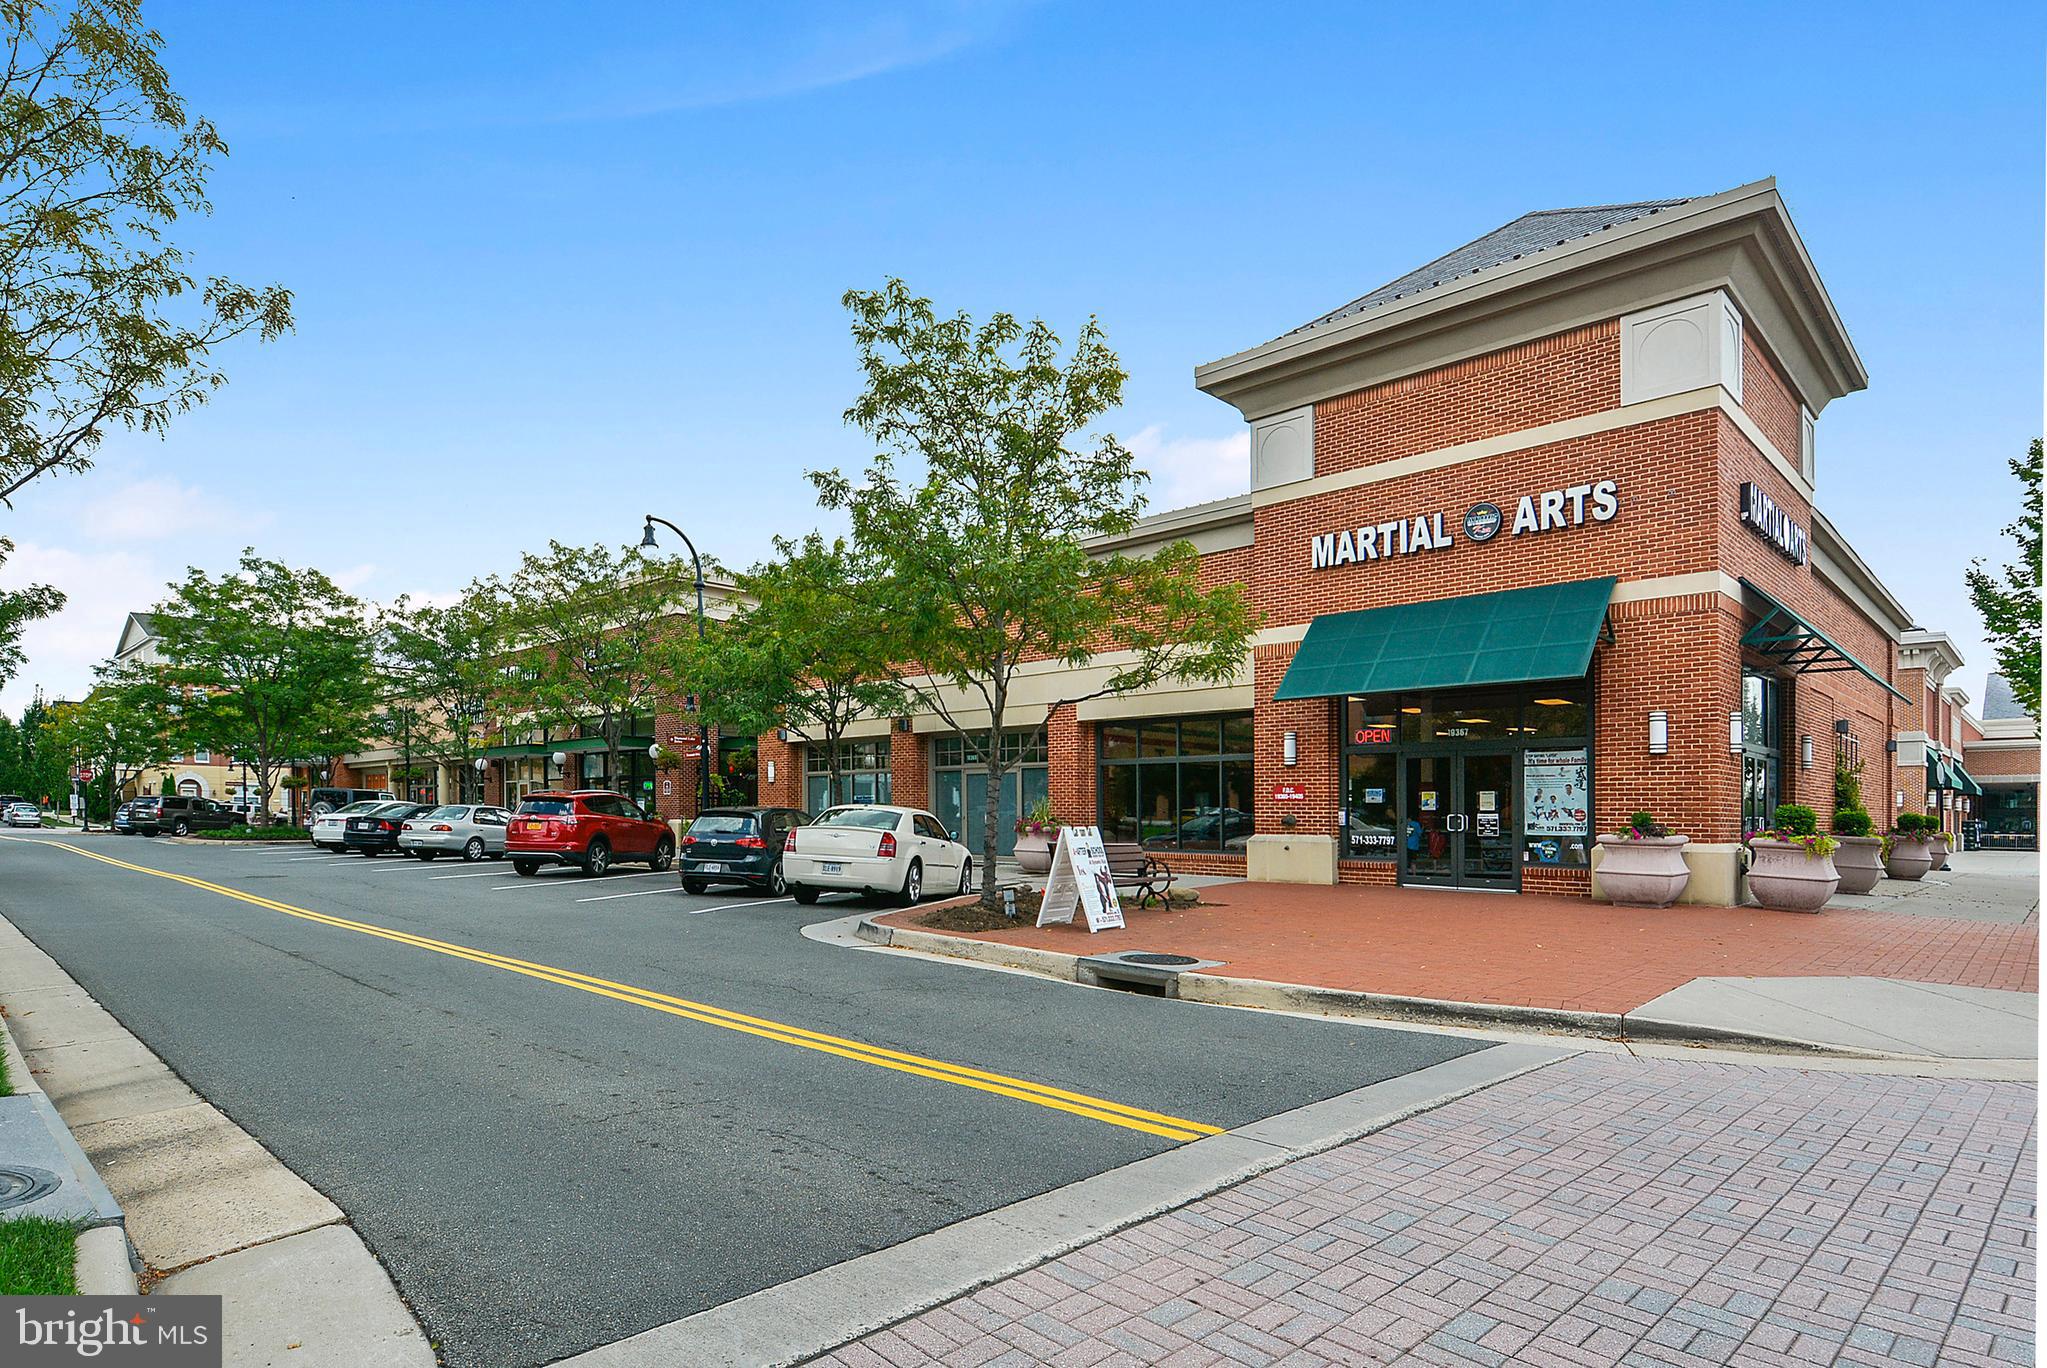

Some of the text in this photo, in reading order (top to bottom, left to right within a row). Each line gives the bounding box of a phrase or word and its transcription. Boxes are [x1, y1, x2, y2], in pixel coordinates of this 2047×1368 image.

[1311, 480, 1618, 569] MARTIAL ARTS
[1750, 481, 1807, 567] MARTIAL ARTS
[1355, 729, 1391, 744] OPEN
[1351, 835, 1395, 846] 571-333-7797
